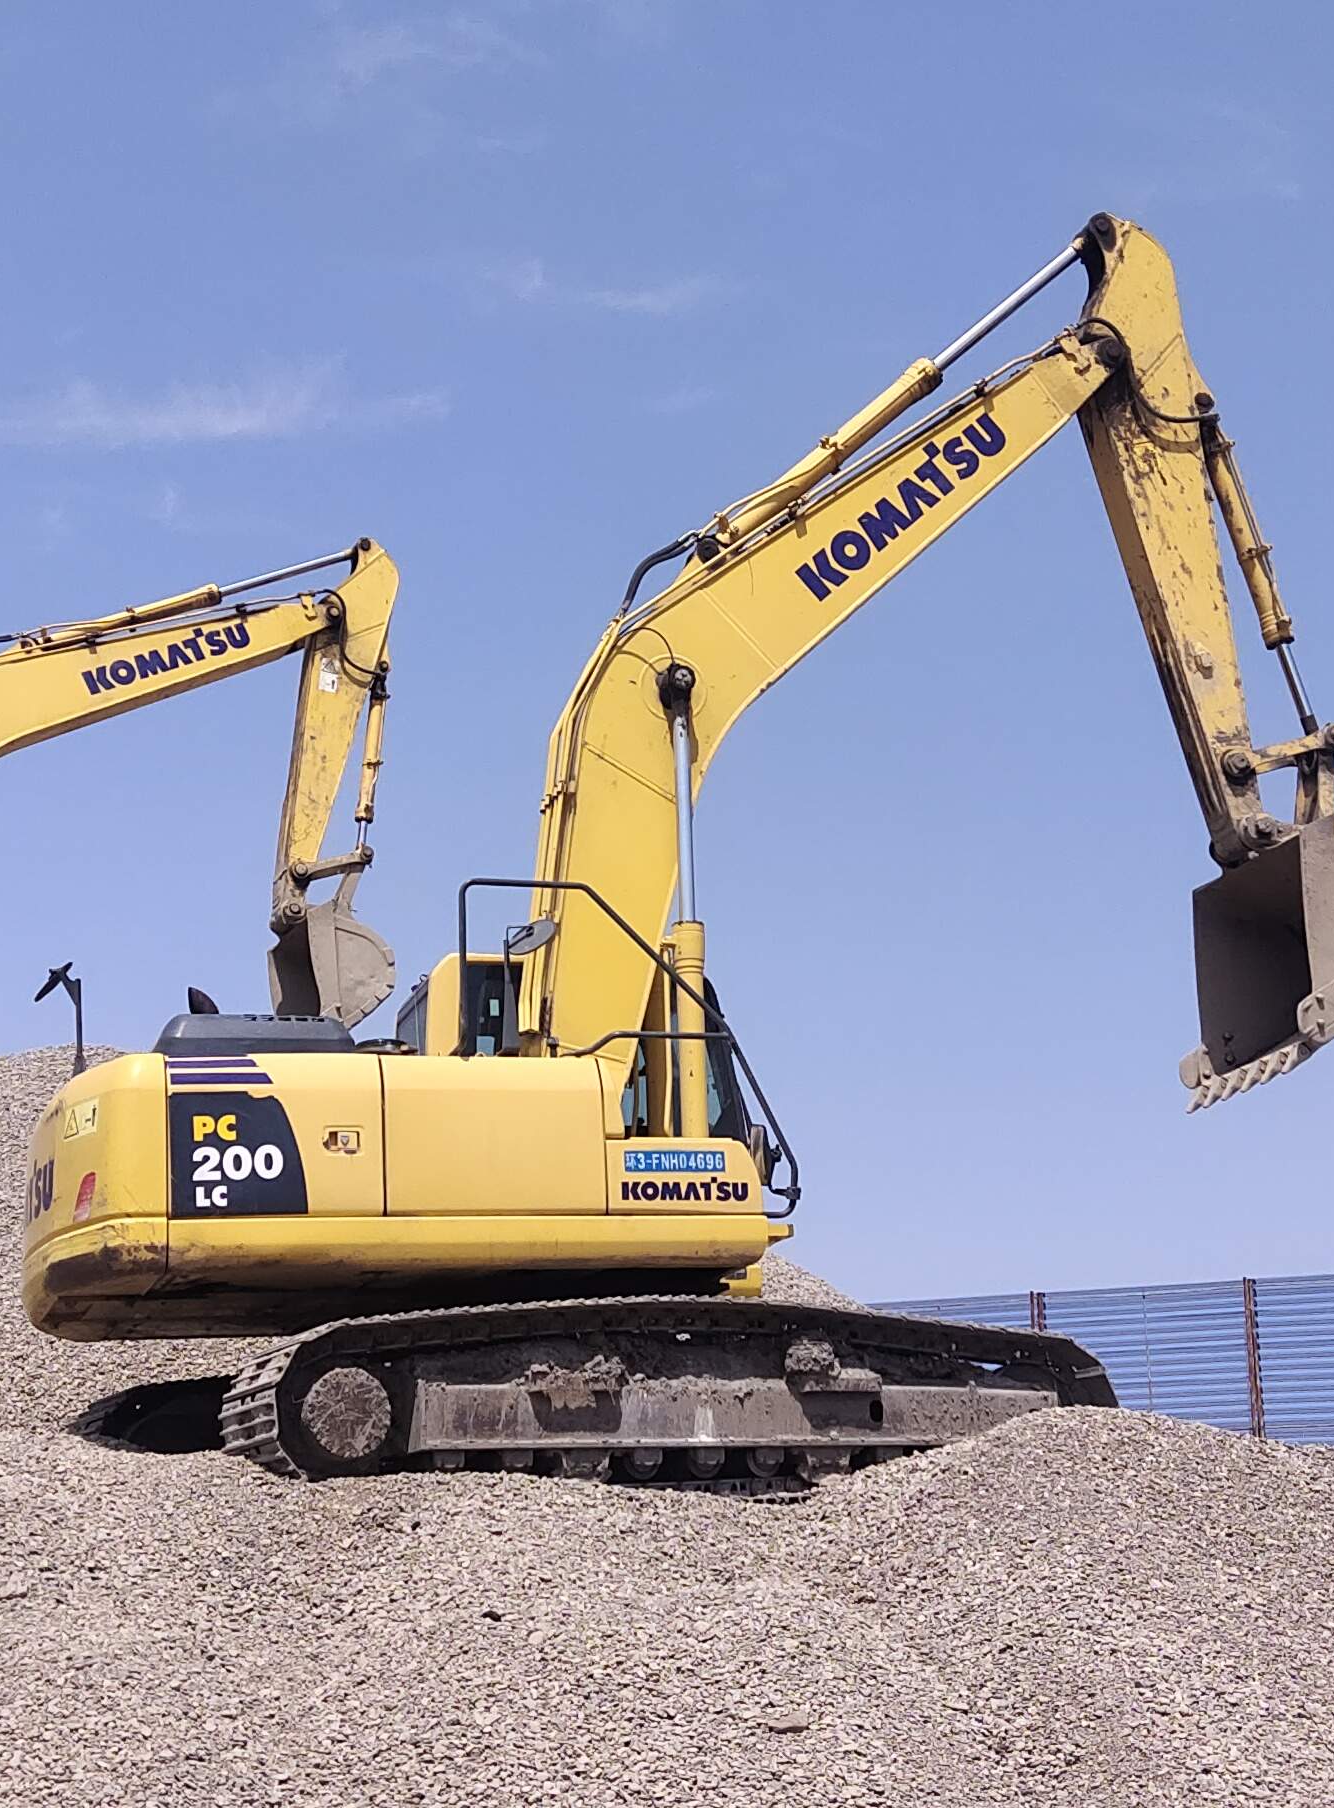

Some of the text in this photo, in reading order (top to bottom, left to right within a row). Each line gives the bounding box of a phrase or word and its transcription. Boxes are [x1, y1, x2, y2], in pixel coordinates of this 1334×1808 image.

[795, 413, 1006, 602] KOMATSU
[81, 623, 251, 695] KOMATSU
[192, 1114, 237, 1142] PC
[192, 1144, 284, 1181] 200
[195, 1186, 228, 1207] LC
[621, 1177, 749, 1201] KOMATSU
